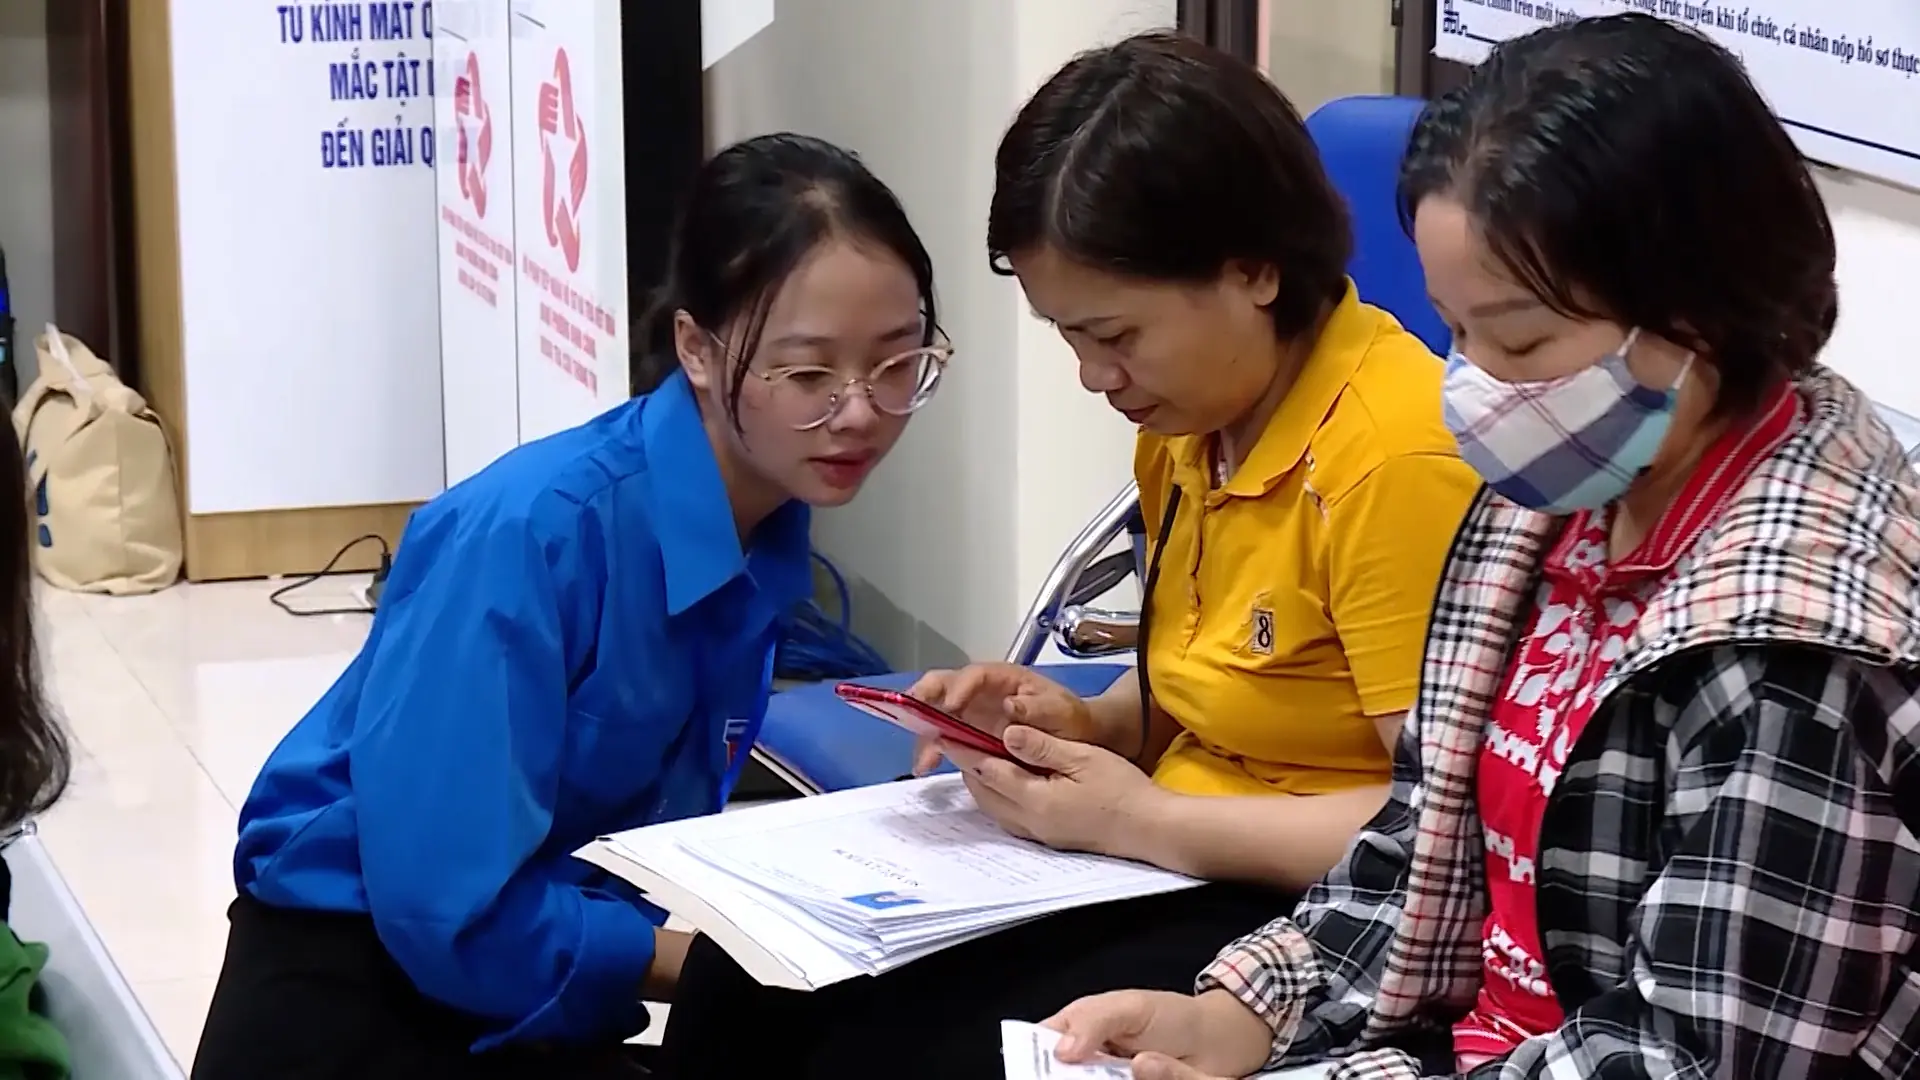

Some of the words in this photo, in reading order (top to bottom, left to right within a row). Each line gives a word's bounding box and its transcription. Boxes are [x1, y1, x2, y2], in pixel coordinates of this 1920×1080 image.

[1717, 5, 1736, 30] khi
[1783, 22, 1797, 46] cá
[1799, 26, 1829, 54] nhân
[1831, 34, 1855, 64] nộp
[329, 47, 379, 101] MẮC
[382, 51, 421, 107] TẬT
[321, 117, 364, 168] ĐẾN
[371, 115, 414, 167] GIẢI
